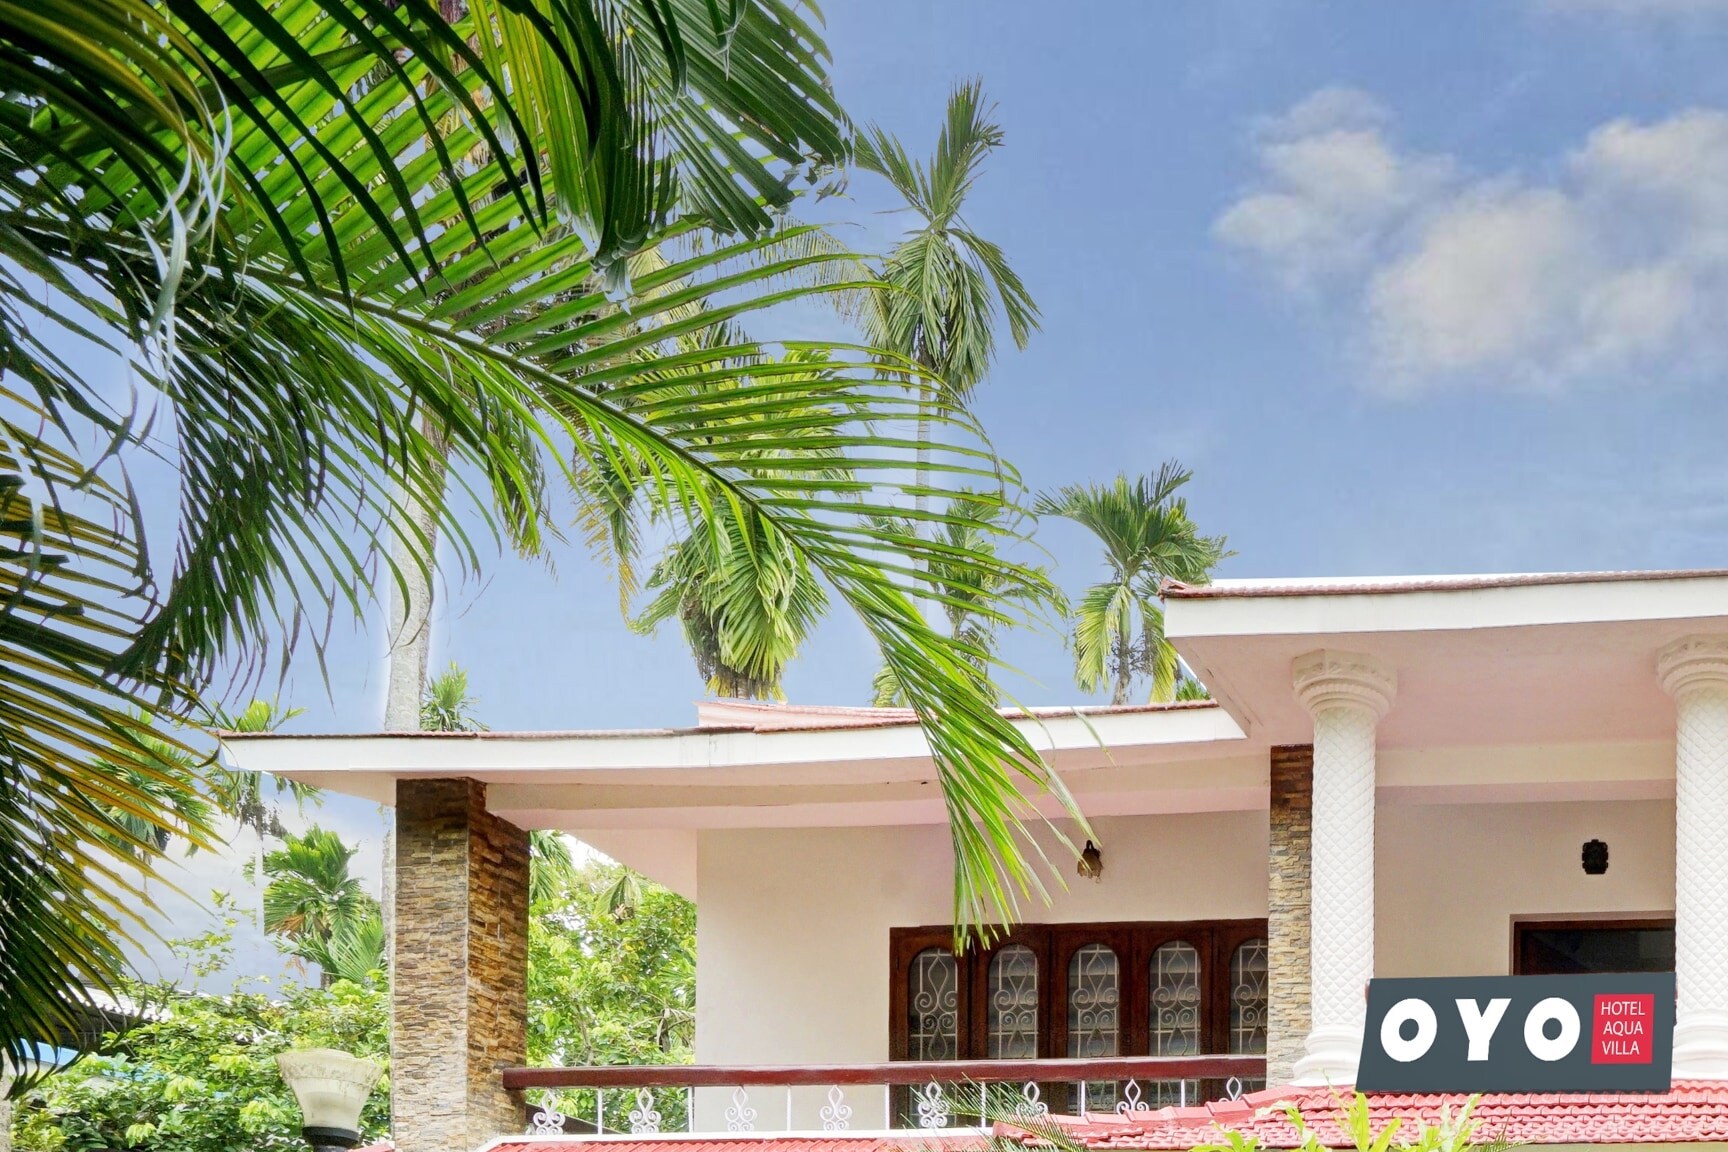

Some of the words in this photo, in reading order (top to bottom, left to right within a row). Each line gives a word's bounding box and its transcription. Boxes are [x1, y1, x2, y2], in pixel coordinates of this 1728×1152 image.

[1601, 1001, 1645, 1015] HOTEL
[1380, 997, 1581, 1062] OYO
[1603, 1021, 1643, 1036] AQUA
[1602, 1041, 1640, 1055] VILLA
